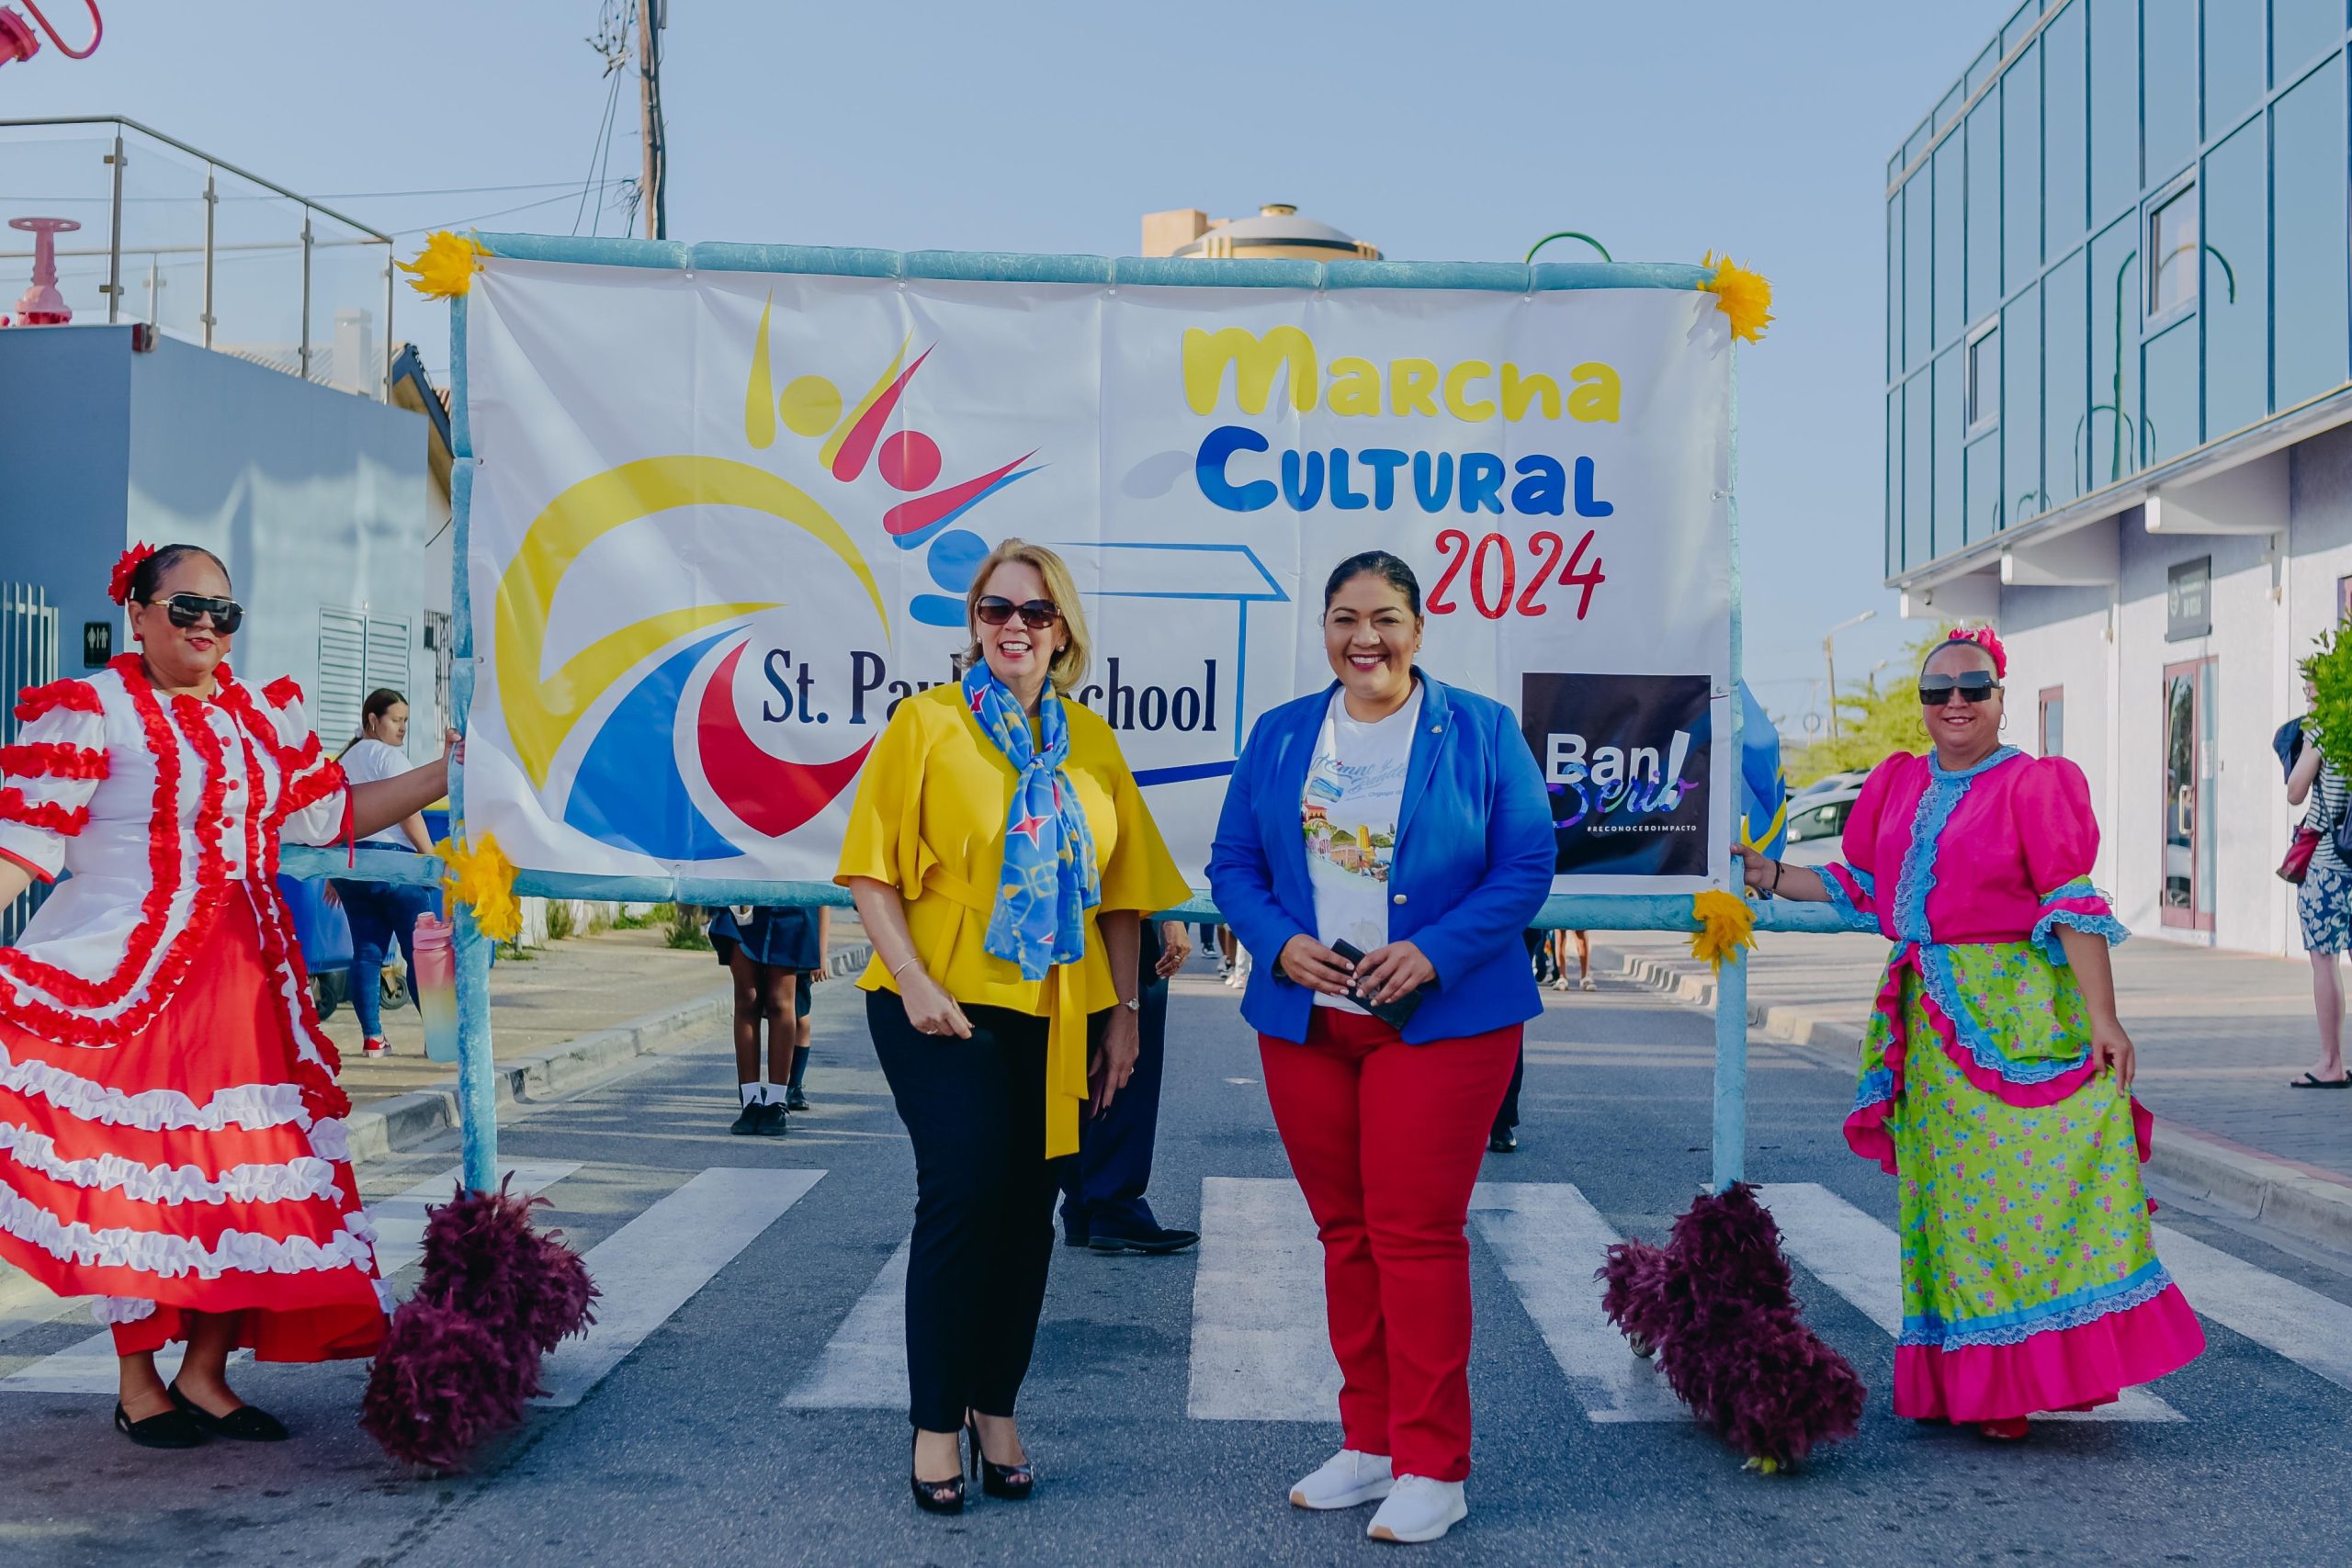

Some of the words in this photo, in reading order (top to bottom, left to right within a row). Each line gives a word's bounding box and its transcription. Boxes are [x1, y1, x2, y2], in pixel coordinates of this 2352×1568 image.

[1426, 528, 1605, 620] 2024
[763, 649, 829, 725] St.
[1066, 658, 1216, 731] chool
